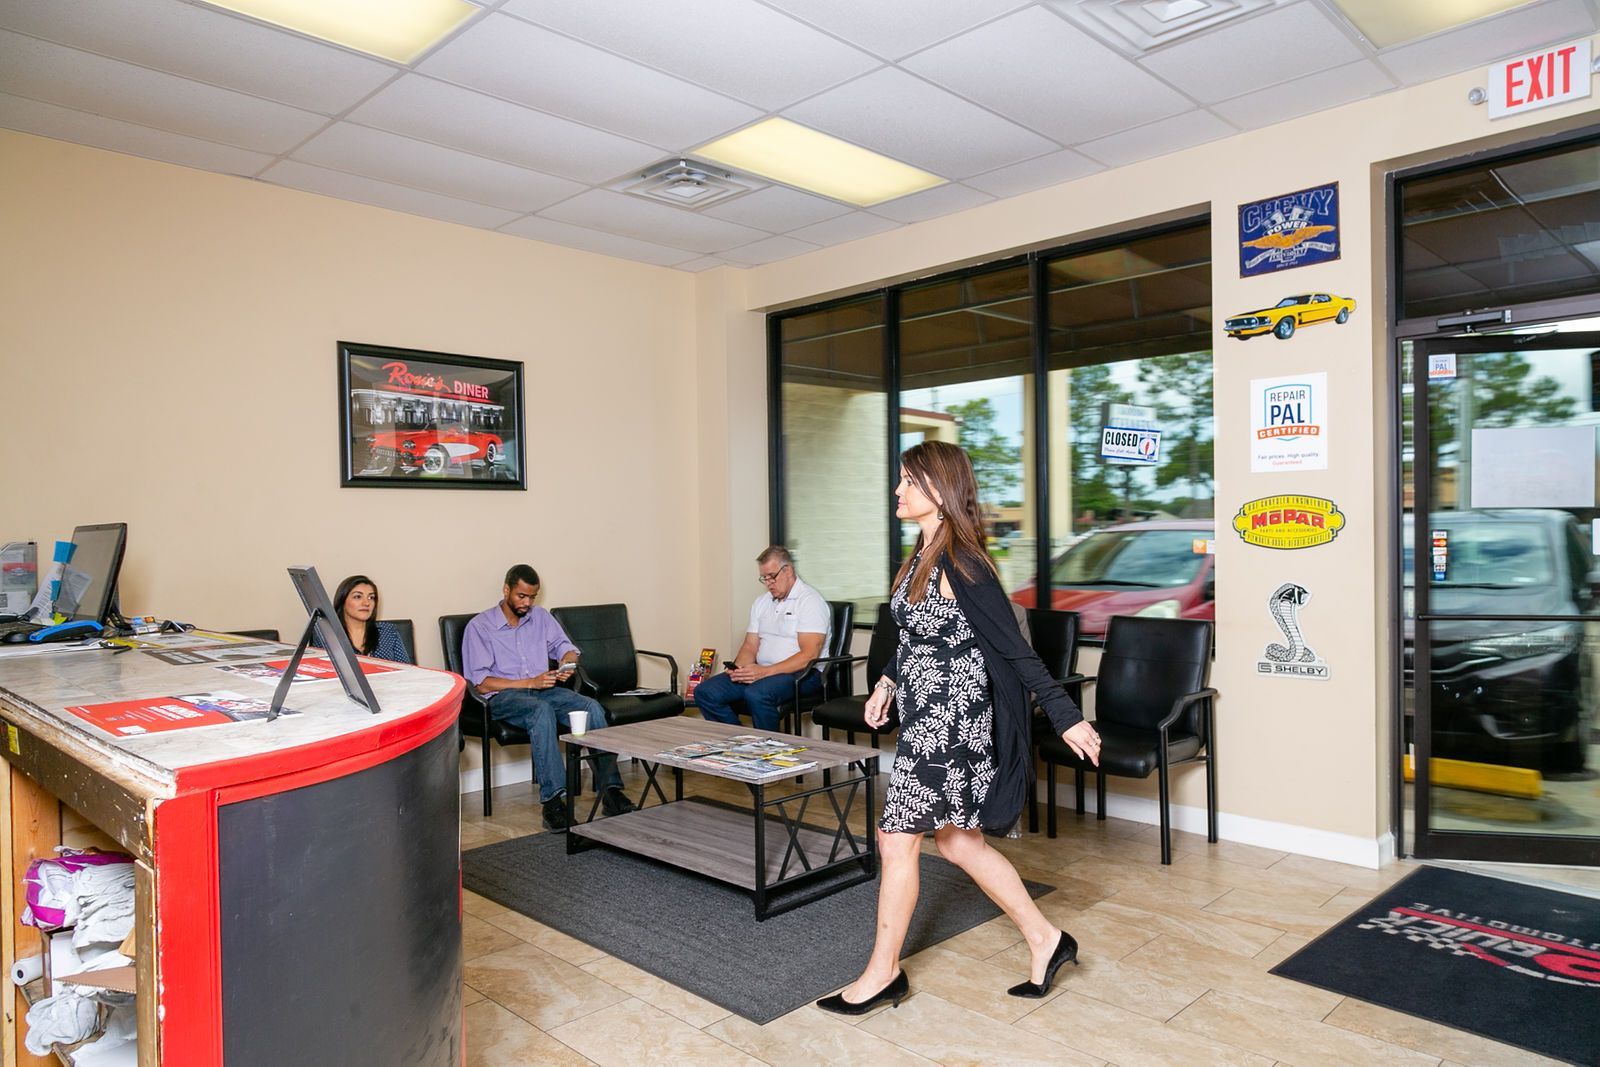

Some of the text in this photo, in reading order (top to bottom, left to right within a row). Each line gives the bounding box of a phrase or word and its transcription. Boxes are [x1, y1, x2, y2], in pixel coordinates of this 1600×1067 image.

[1505, 46, 1576, 108] EXIT
[1242, 189, 1334, 233] CHEVY
[1267, 221, 1308, 236] POWER
[453, 380, 489, 399] DINER
[1270, 390, 1306, 402] REPAIR
[1270, 403, 1305, 425] PAL
[1105, 431, 1138, 447] CLOSED
[1259, 427, 1318, 438] CERTIFIED
[1252, 509, 1325, 530] MOPAR
[1275, 665, 1324, 674] SHELBY
[1366, 911, 1548, 958] QUICK
